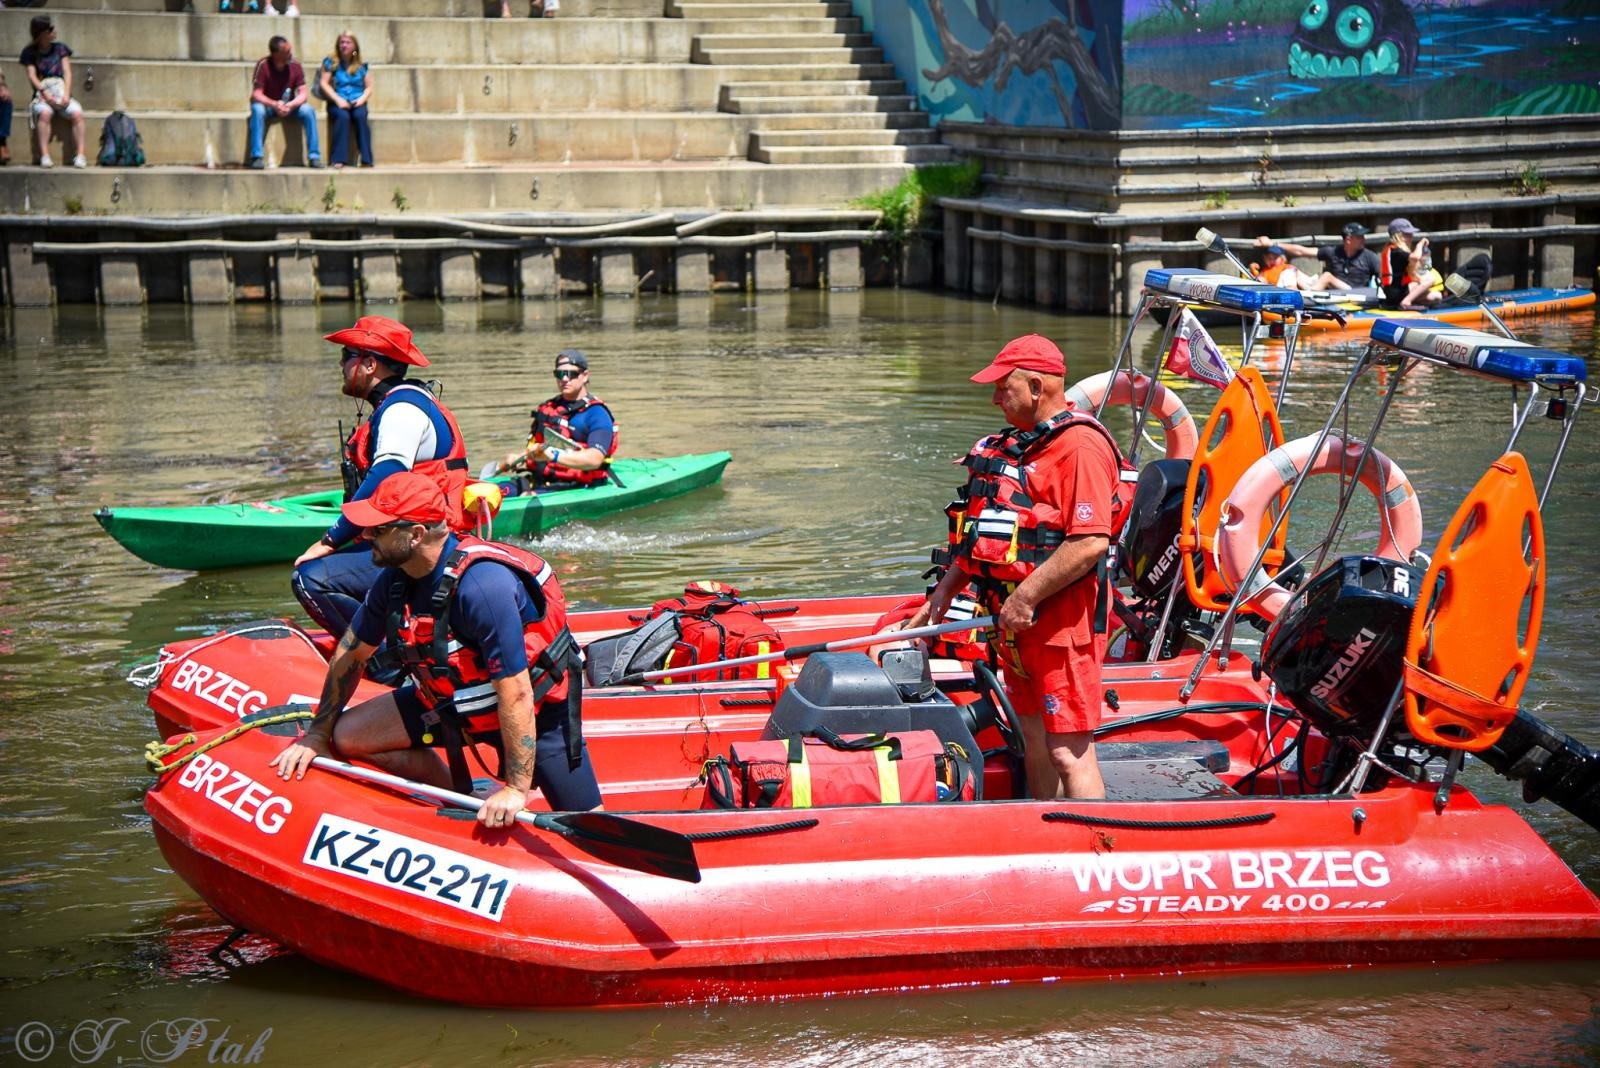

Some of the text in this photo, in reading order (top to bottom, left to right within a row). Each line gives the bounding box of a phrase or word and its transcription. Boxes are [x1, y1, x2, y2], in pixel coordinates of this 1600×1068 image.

[1190, 281, 1212, 298] WOPR
[1435, 340, 1468, 361] WOPR
[1147, 533, 1182, 585] MERC
[171, 659, 268, 718] BRZEG
[1310, 627, 1377, 699] SUZUKI
[178, 753, 293, 834] BRZEG
[310, 825, 509, 915] KŹ-02-211
[1070, 850, 1391, 892] WOPR BRZEG
[1116, 893, 1330, 913] STEADY 400
